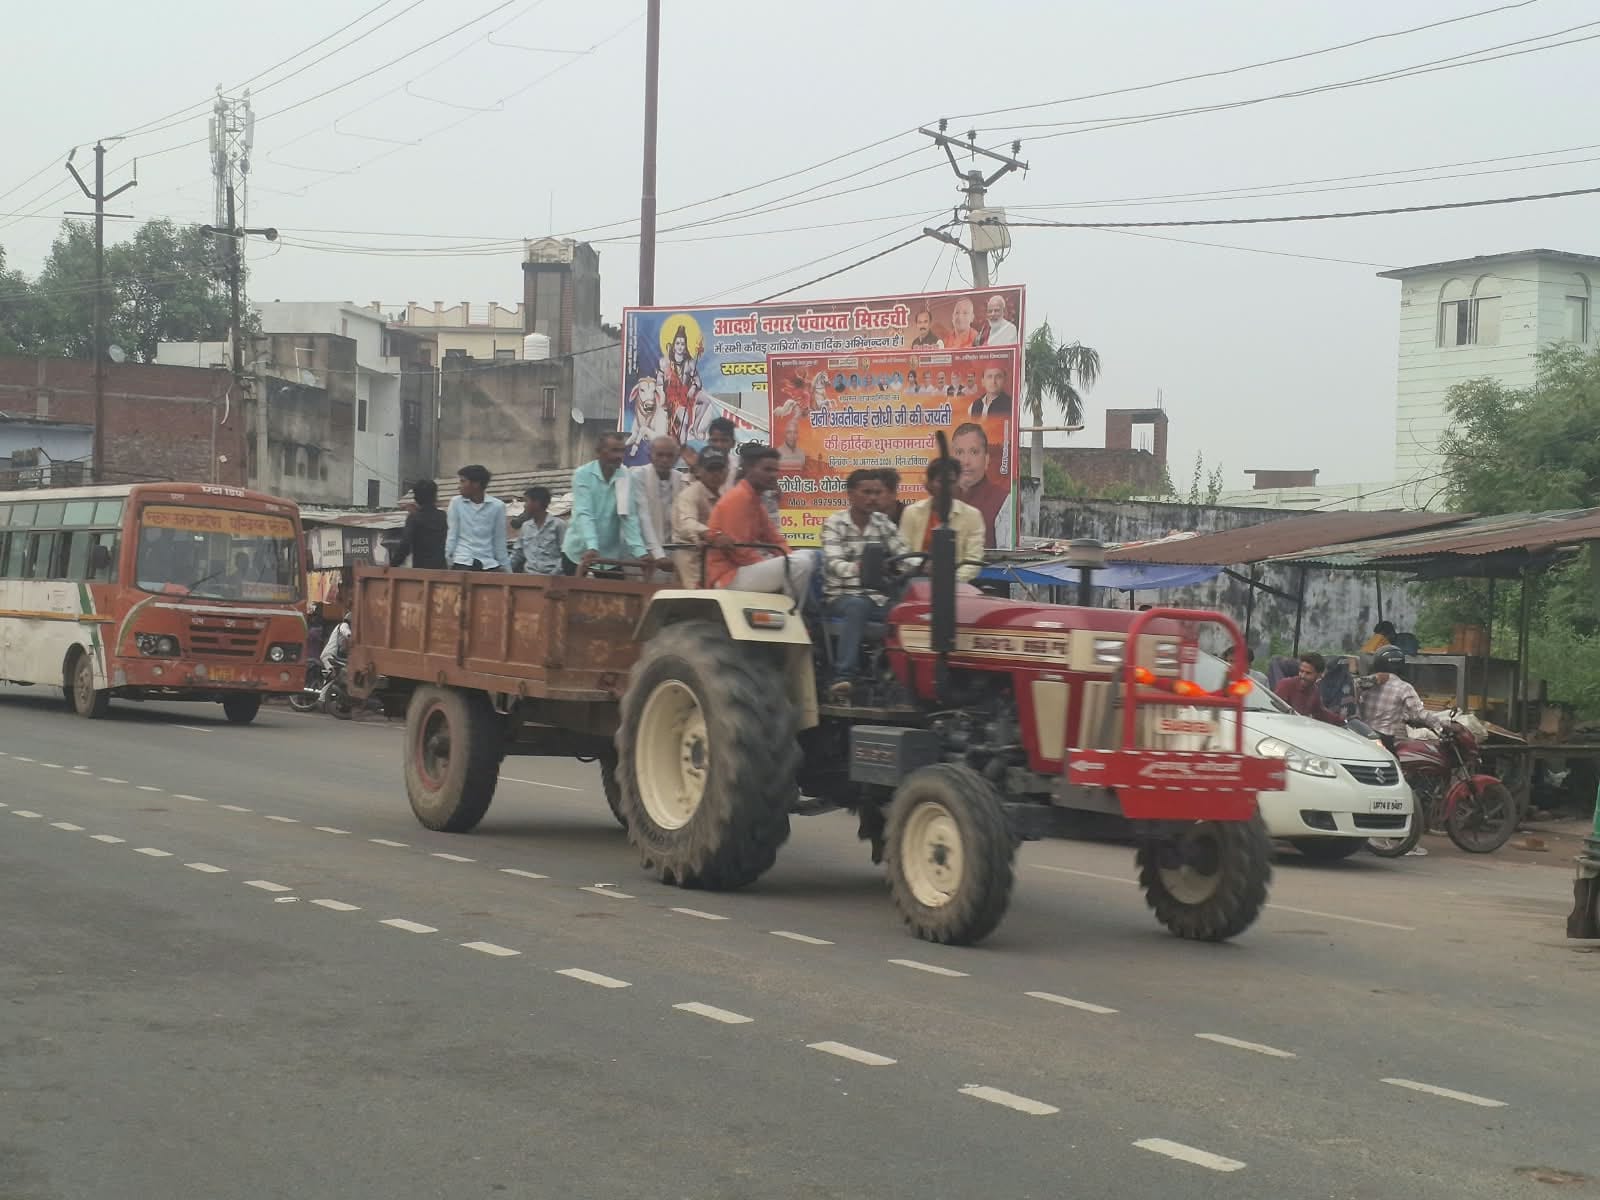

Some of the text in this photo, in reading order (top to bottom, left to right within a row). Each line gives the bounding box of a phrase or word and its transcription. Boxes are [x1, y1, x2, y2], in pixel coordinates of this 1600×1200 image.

[714, 312, 757, 335] आदर्श
[762, 316, 793, 333] नगर
[798, 309, 850, 331] पंचायत
[724, 340, 742, 353] सभी
[770, 338, 799, 352] यात्रियों
[800, 339, 813, 351] का
[814, 337, 842, 351] हार्दिक
[810, 405, 829, 427] रानी
[871, 403, 893, 426] लोधी
[894, 404, 907, 424] जी
[909, 404, 922, 423] की
[924, 402, 951, 424] जयंती
[824, 434, 839, 449] की
[840, 434, 873, 451] हार्दिक
